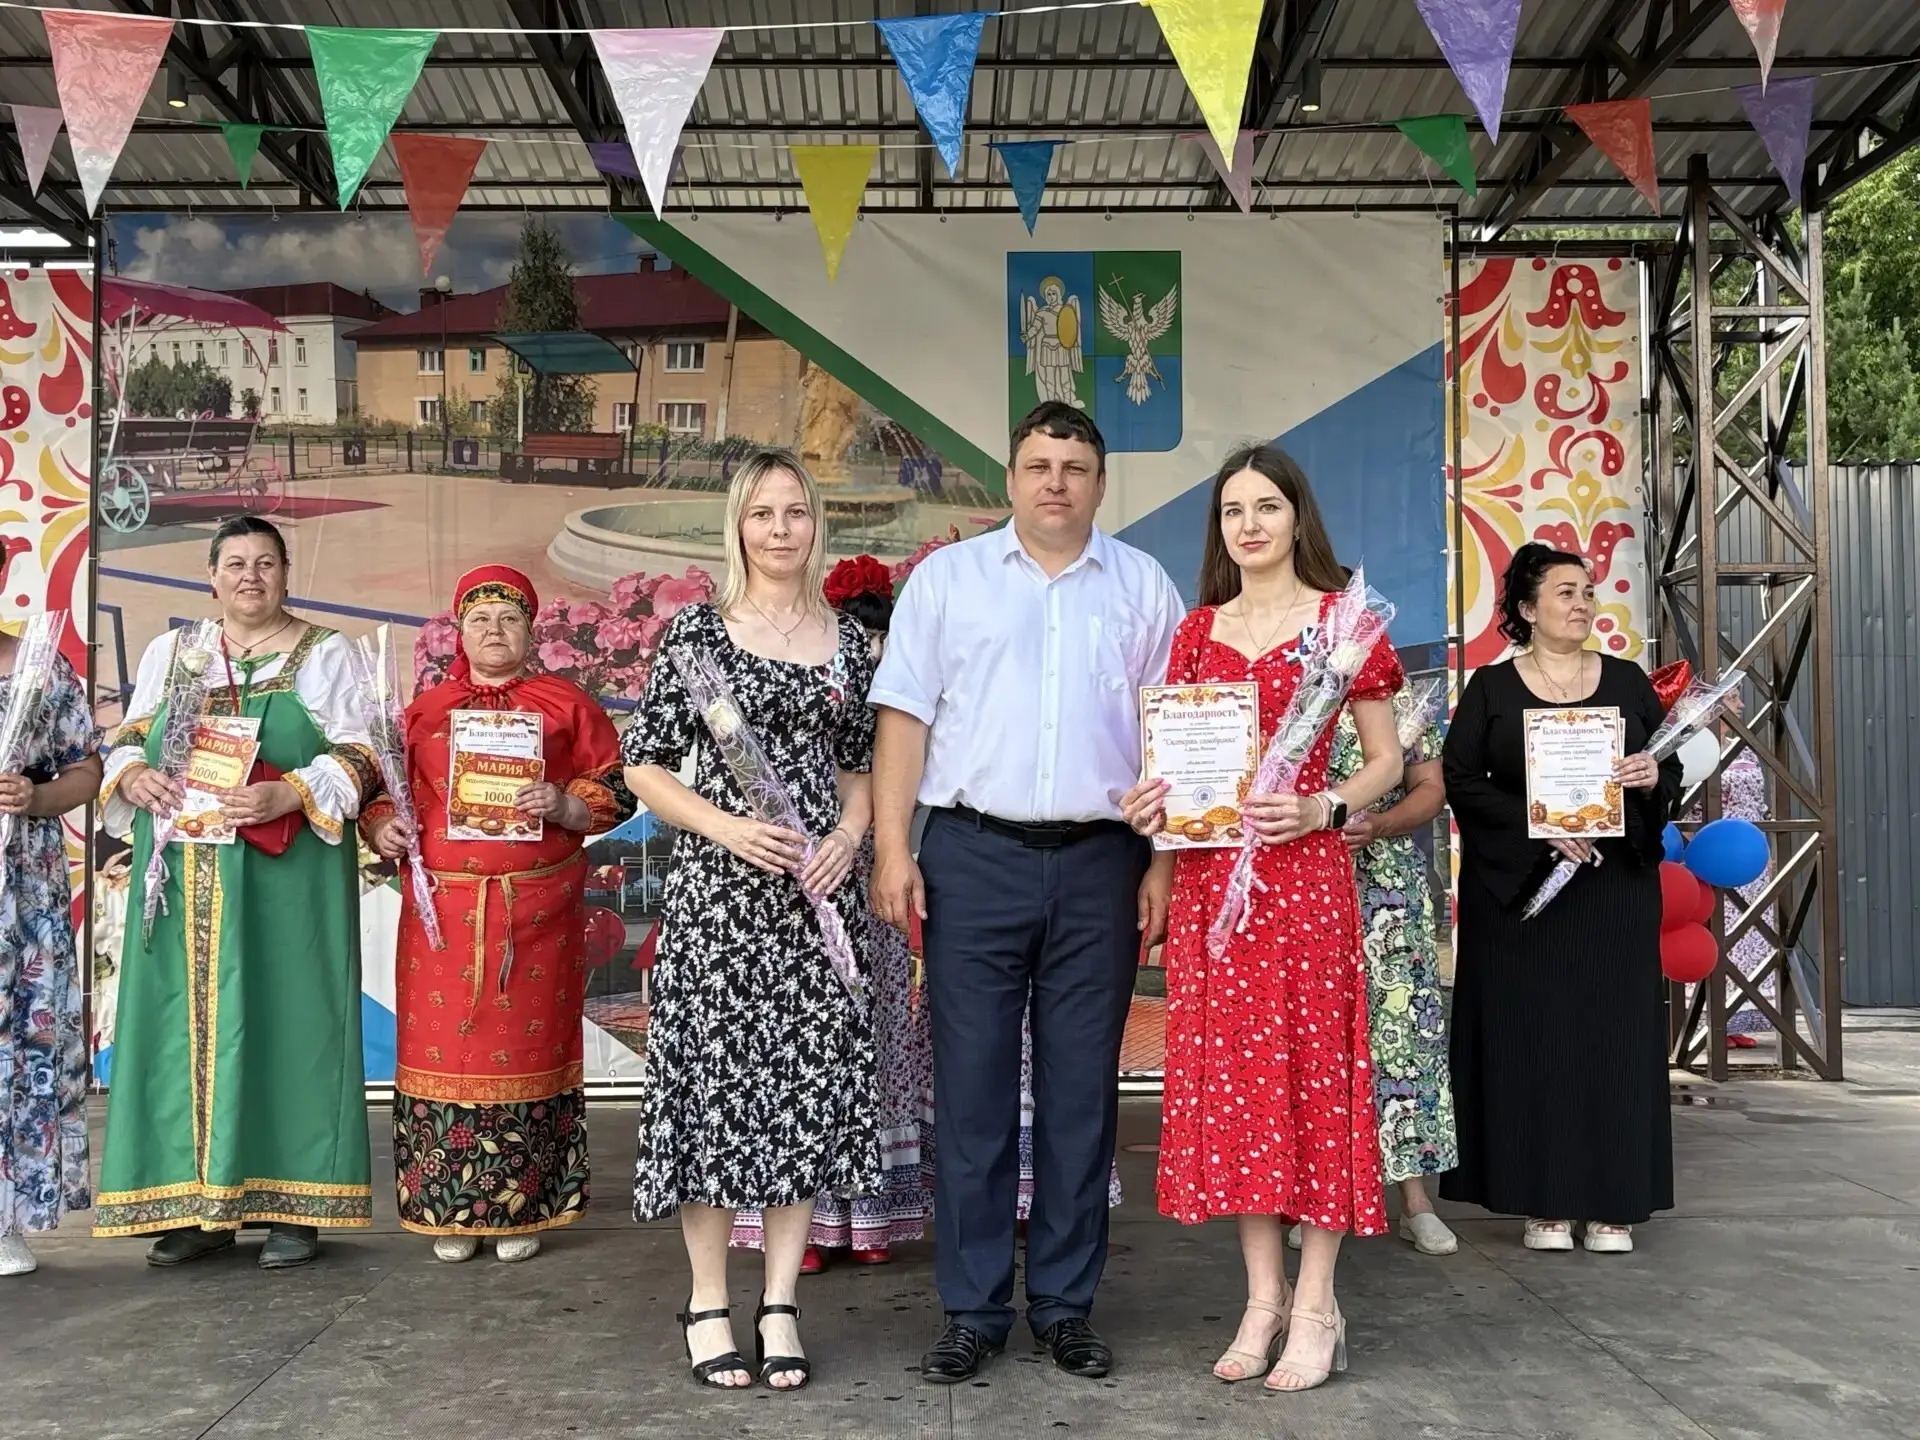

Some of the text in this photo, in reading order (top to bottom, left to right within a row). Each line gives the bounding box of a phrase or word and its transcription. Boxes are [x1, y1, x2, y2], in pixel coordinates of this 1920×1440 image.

[1162, 709, 1238, 720] Благодарность
[469, 728, 529, 740] Благодарность
[1542, 726, 1604, 736] Благодарность
[198, 736, 236, 754] МАРИЯ
[193, 766, 218, 781] 1000
[476, 760, 524, 776] МАРИЯ
[484, 791, 513, 804] 1000
